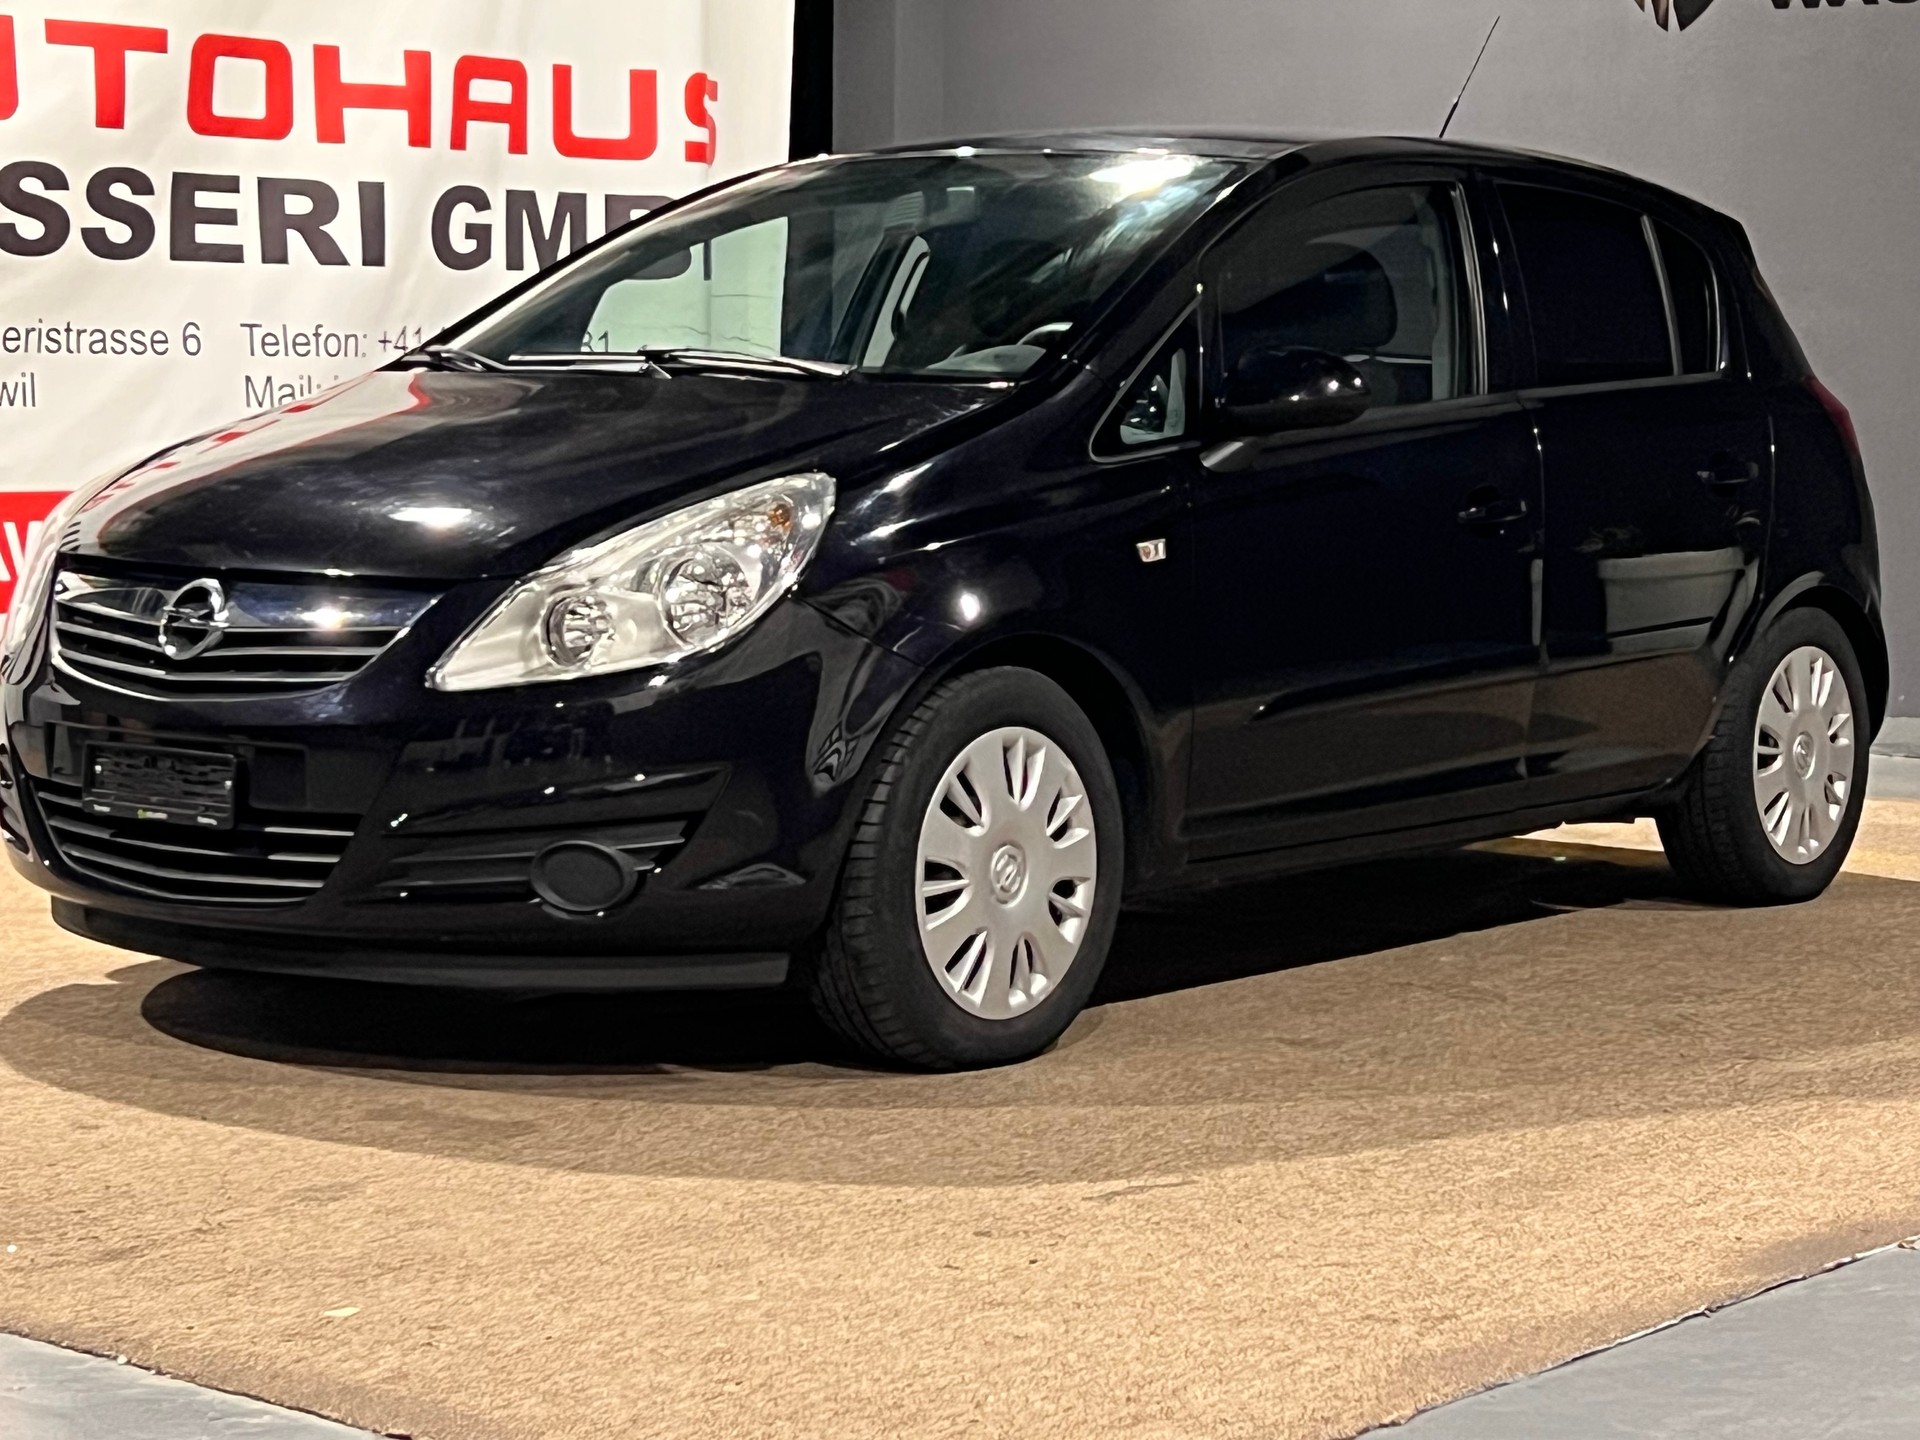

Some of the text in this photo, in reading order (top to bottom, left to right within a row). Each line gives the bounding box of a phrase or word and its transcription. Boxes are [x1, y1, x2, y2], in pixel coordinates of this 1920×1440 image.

[0, 14, 719, 168] TOHAUS
[2, 318, 202, 357] eristrasse 6
[239, 323, 368, 358] Telefon:
